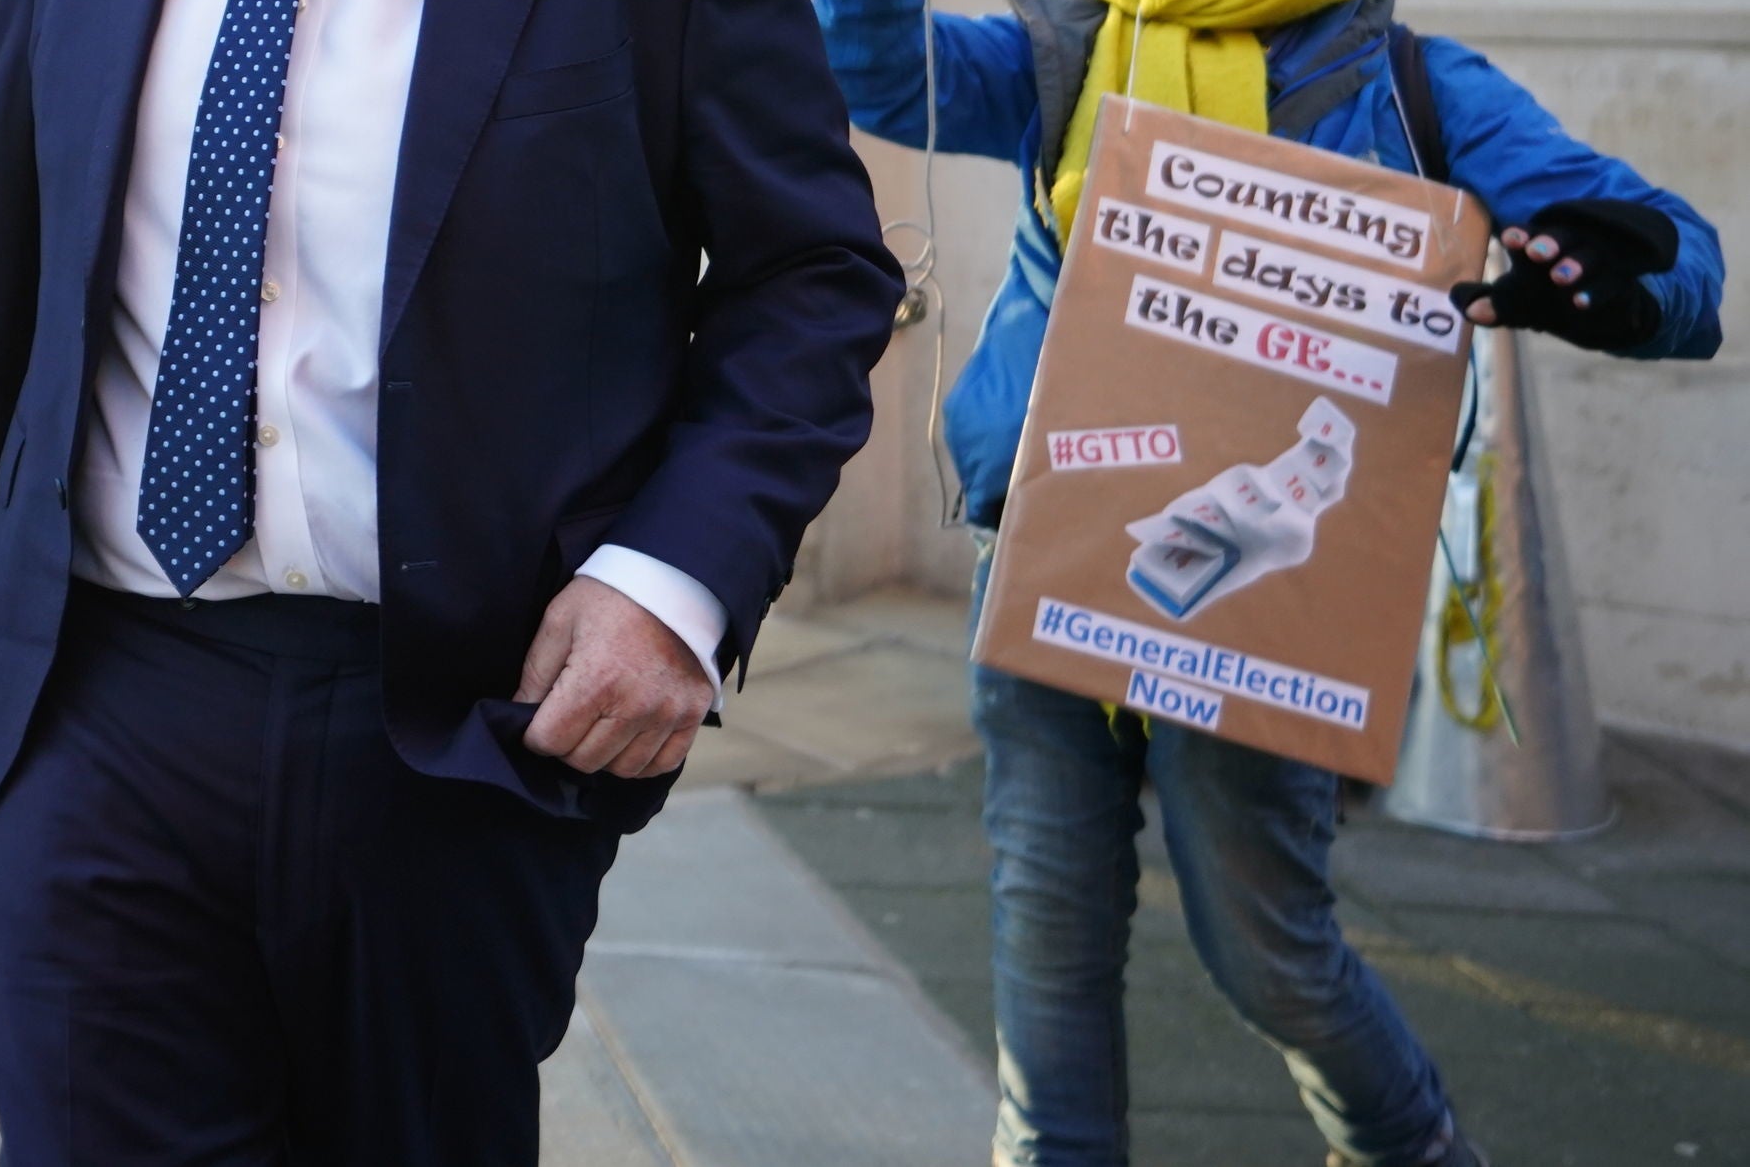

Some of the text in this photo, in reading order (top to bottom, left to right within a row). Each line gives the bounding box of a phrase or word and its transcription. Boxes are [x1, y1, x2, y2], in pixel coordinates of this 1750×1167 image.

[1159, 152, 1425, 259] Counting
[1098, 206, 1455, 337] the days to
[1136, 286, 1383, 391] the GE...
[1051, 428, 1178, 465] #GTTO
[1313, 452, 1327, 469] 9
[1236, 483, 1258, 506] 11
[1286, 474, 1306, 502] 10
[1039, 604, 1365, 724] #GeneralElection
[1127, 671, 1219, 726] Now
